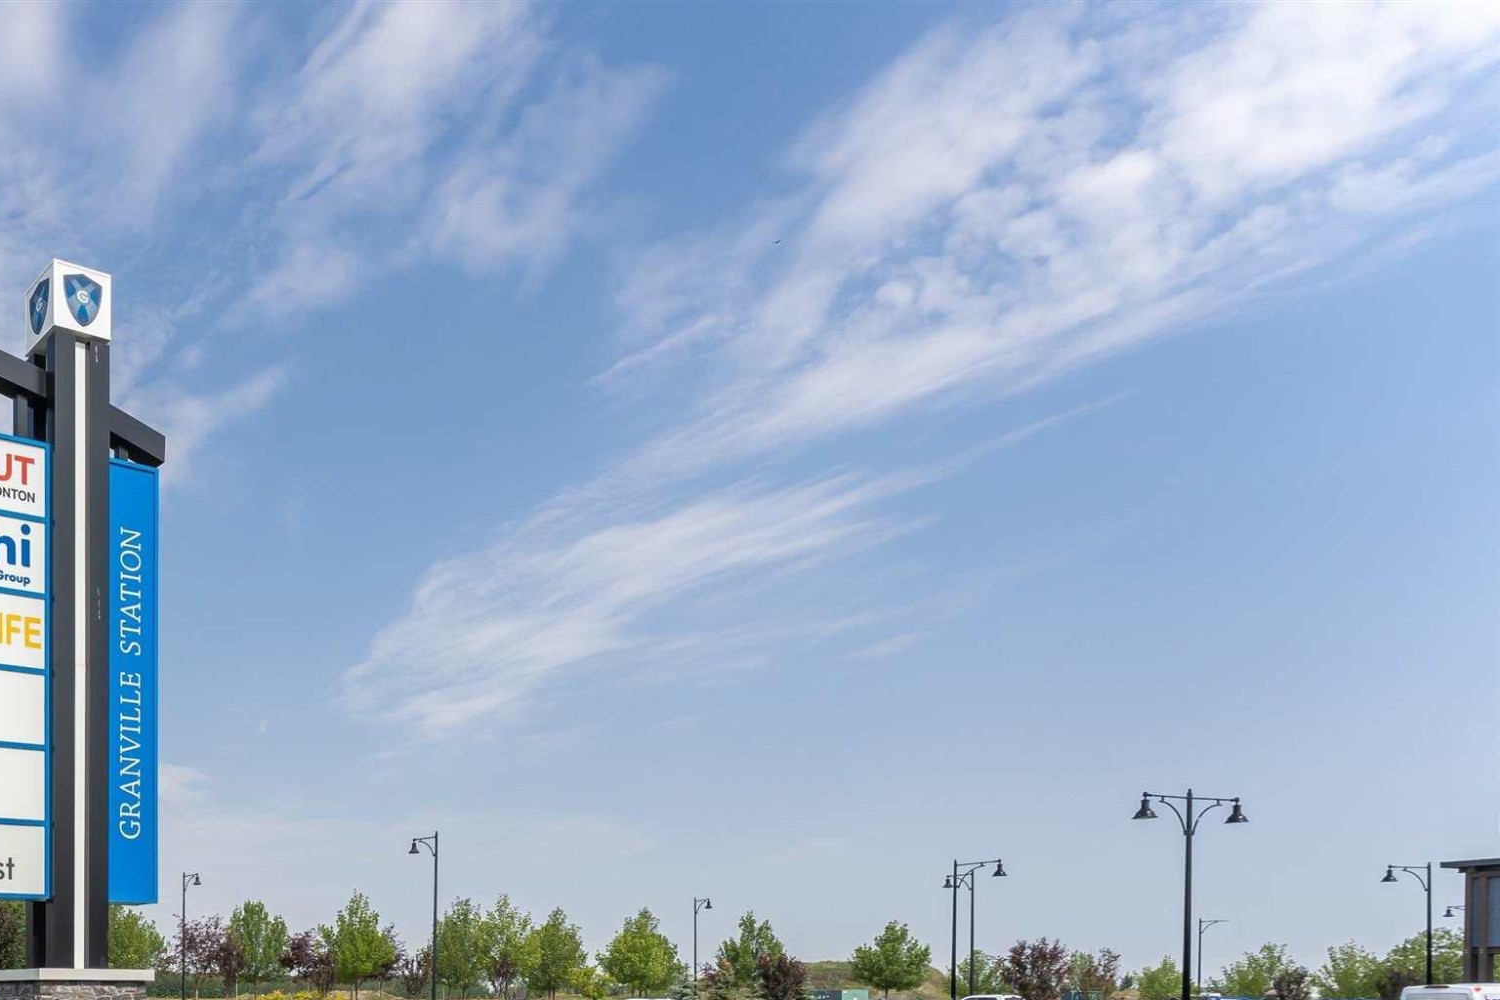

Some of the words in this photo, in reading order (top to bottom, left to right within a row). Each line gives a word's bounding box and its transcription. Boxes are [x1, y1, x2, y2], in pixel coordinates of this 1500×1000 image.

[77, 290, 89, 303] G
[118, 526, 142, 656] STATION
[118, 670, 142, 841] GRANVILLE
